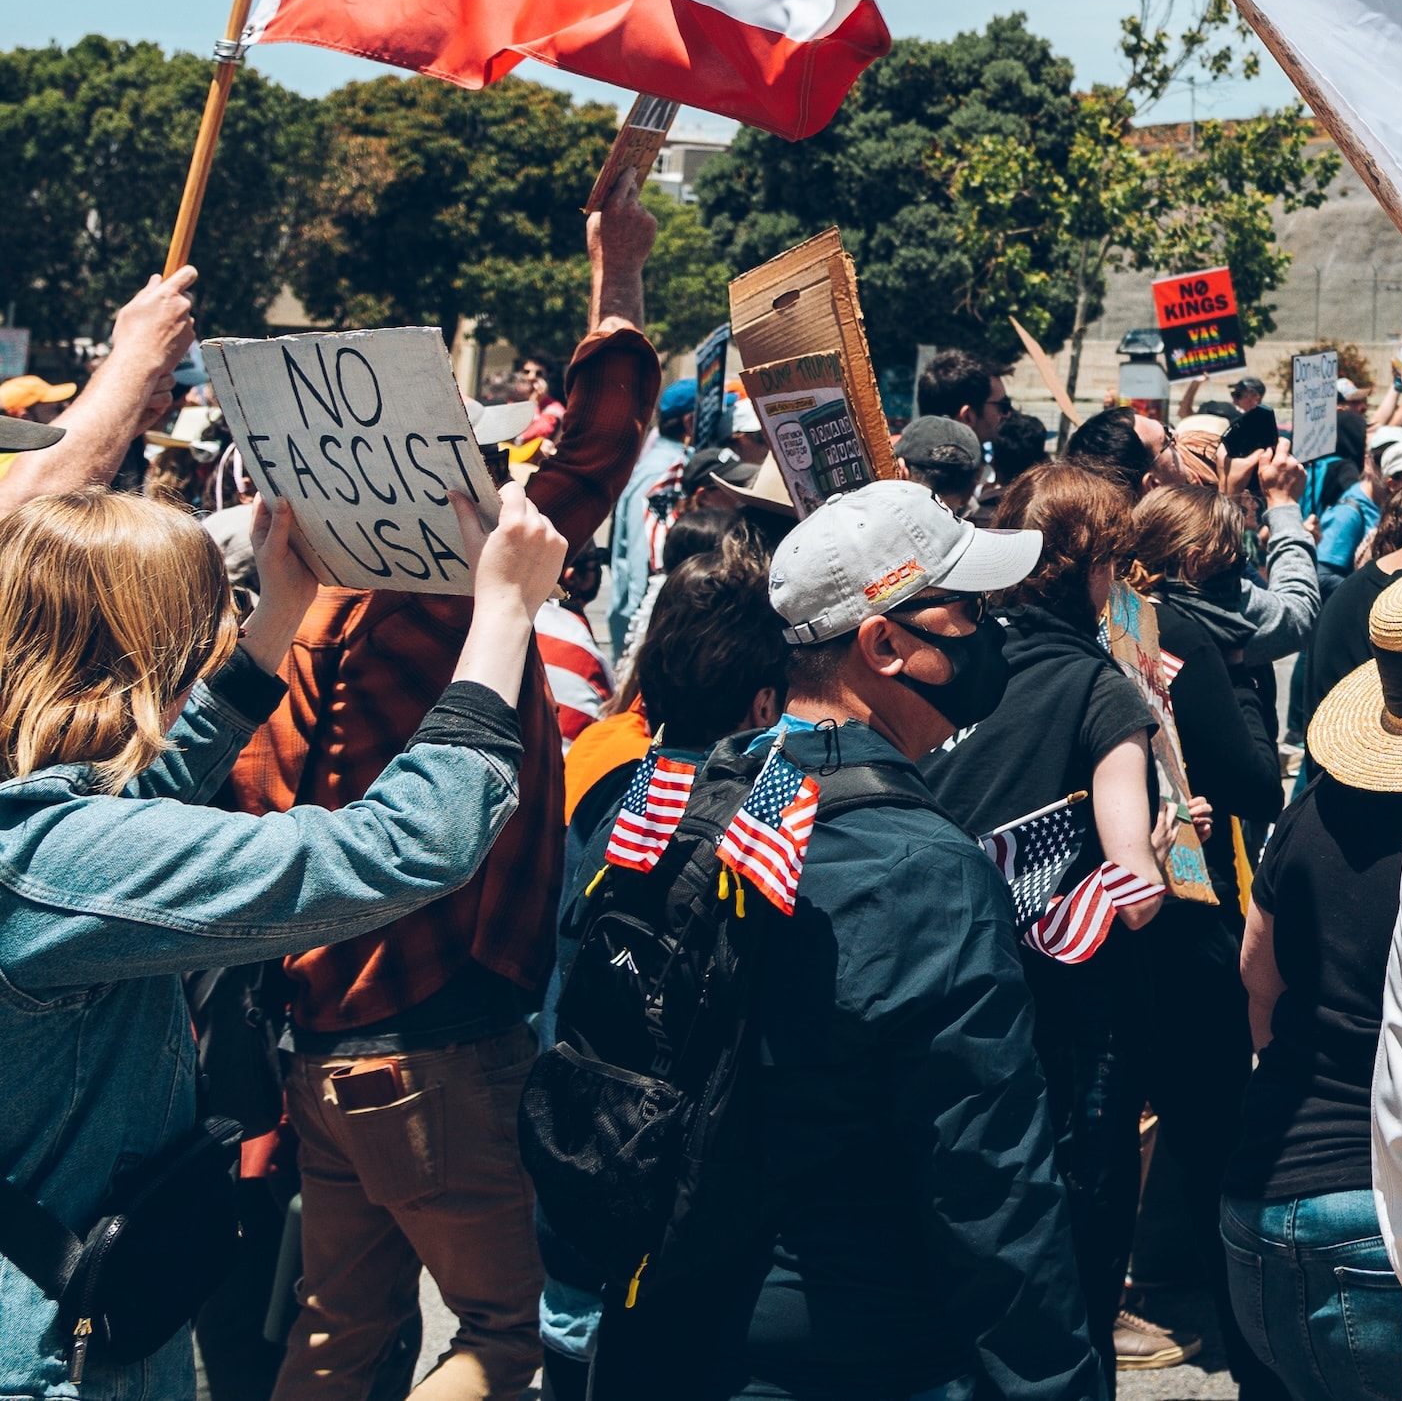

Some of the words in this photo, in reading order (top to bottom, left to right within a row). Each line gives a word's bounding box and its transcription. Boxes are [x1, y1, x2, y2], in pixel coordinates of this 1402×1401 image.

[1164, 294, 1229, 321] KINGS
[1179, 280, 1209, 300] NO
[281, 344, 383, 429] NO
[759, 363, 792, 392] DUMP
[248, 433, 480, 506] FASCIST
[325, 517, 469, 582] USA
[863, 558, 926, 600] SHOCK
